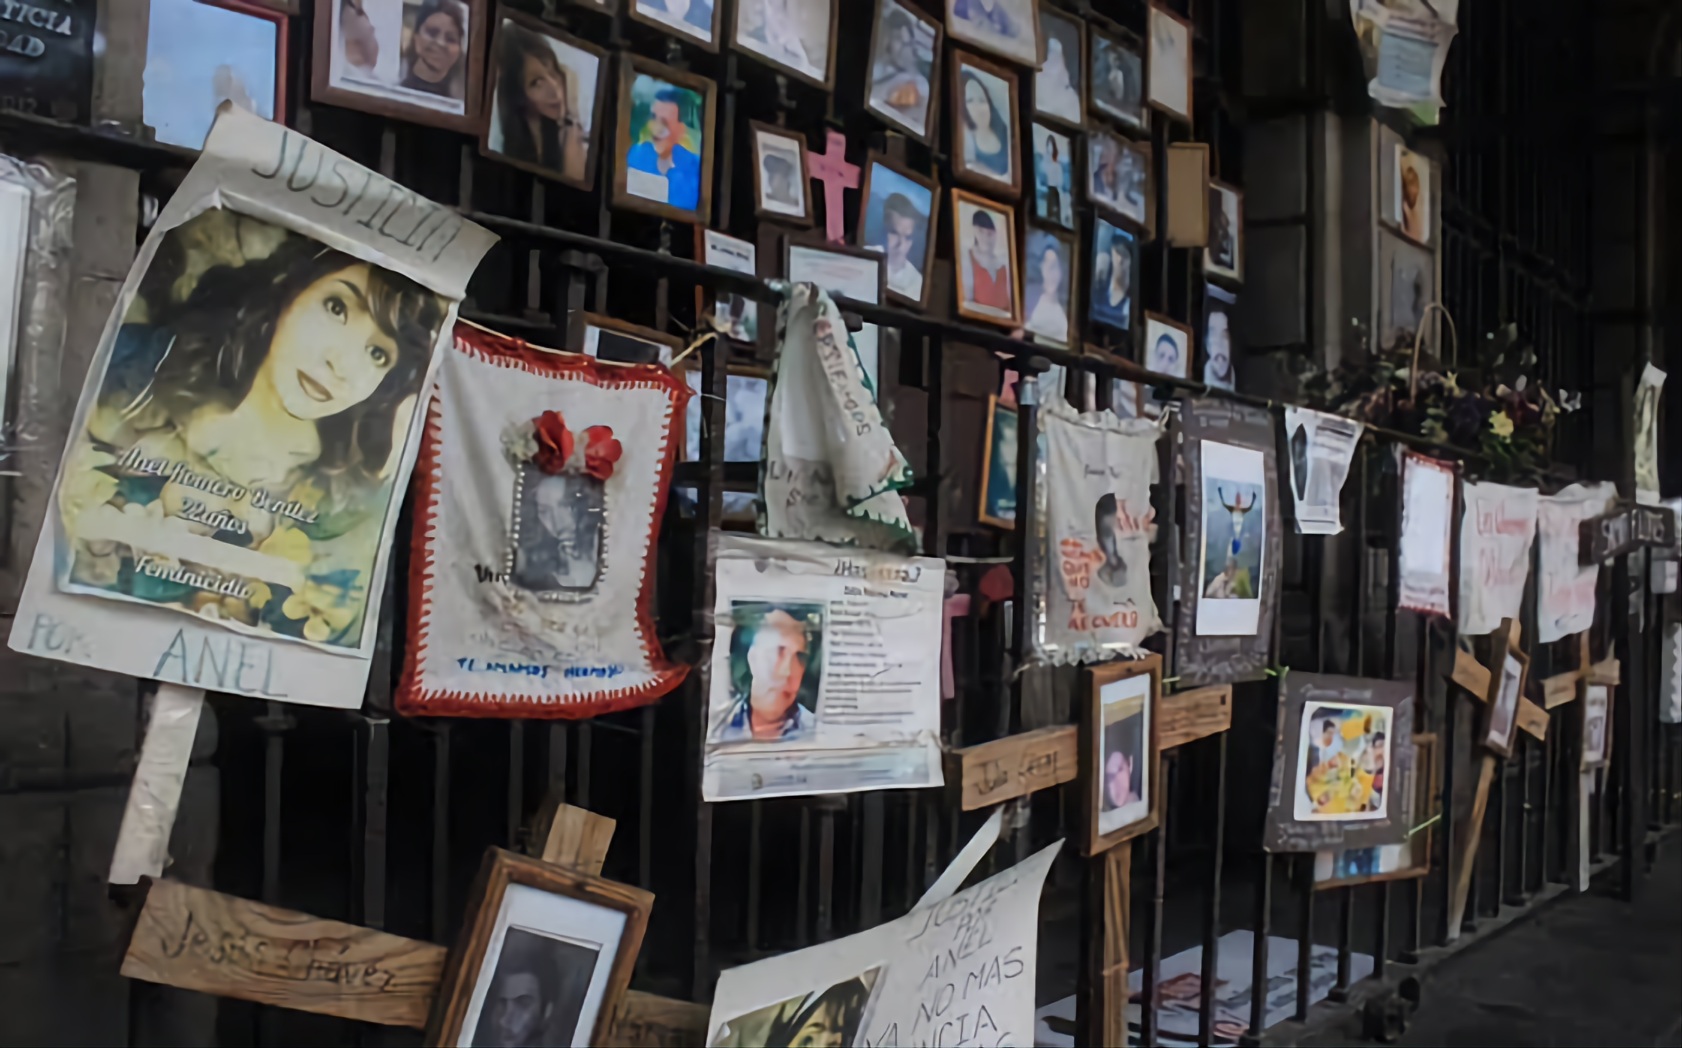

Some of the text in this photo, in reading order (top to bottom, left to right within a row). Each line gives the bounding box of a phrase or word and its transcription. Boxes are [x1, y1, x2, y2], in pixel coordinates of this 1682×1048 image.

[250, 129, 462, 263] JUSTICIA
[117, 447, 168, 477] Anel
[135, 555, 257, 600] Feminicidio
[151, 627, 289, 698] ANEL
[910, 945, 1025, 1036] NO MAS
